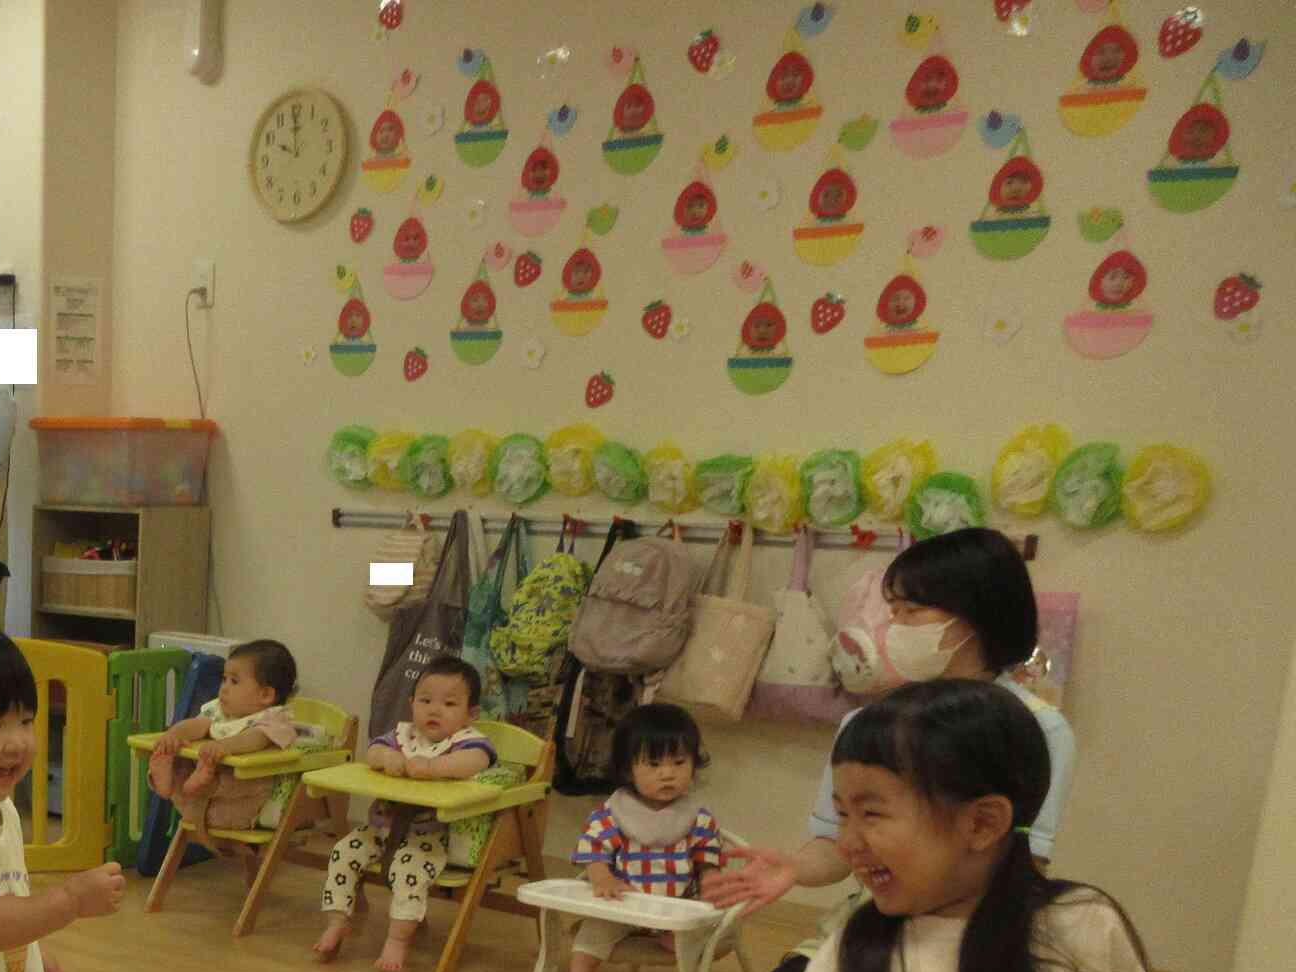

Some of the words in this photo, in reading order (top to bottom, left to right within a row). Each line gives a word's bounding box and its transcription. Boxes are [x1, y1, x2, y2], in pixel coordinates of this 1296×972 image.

[276, 113, 285, 127] 11
[321, 119, 329, 132] 2
[327, 140, 334, 153] 3
[262, 155, 269, 168] 9
[320, 162, 326, 176] 4
[265, 176, 273, 189] 8
[293, 191, 301, 204] 6
[404, 668, 421, 681] co
